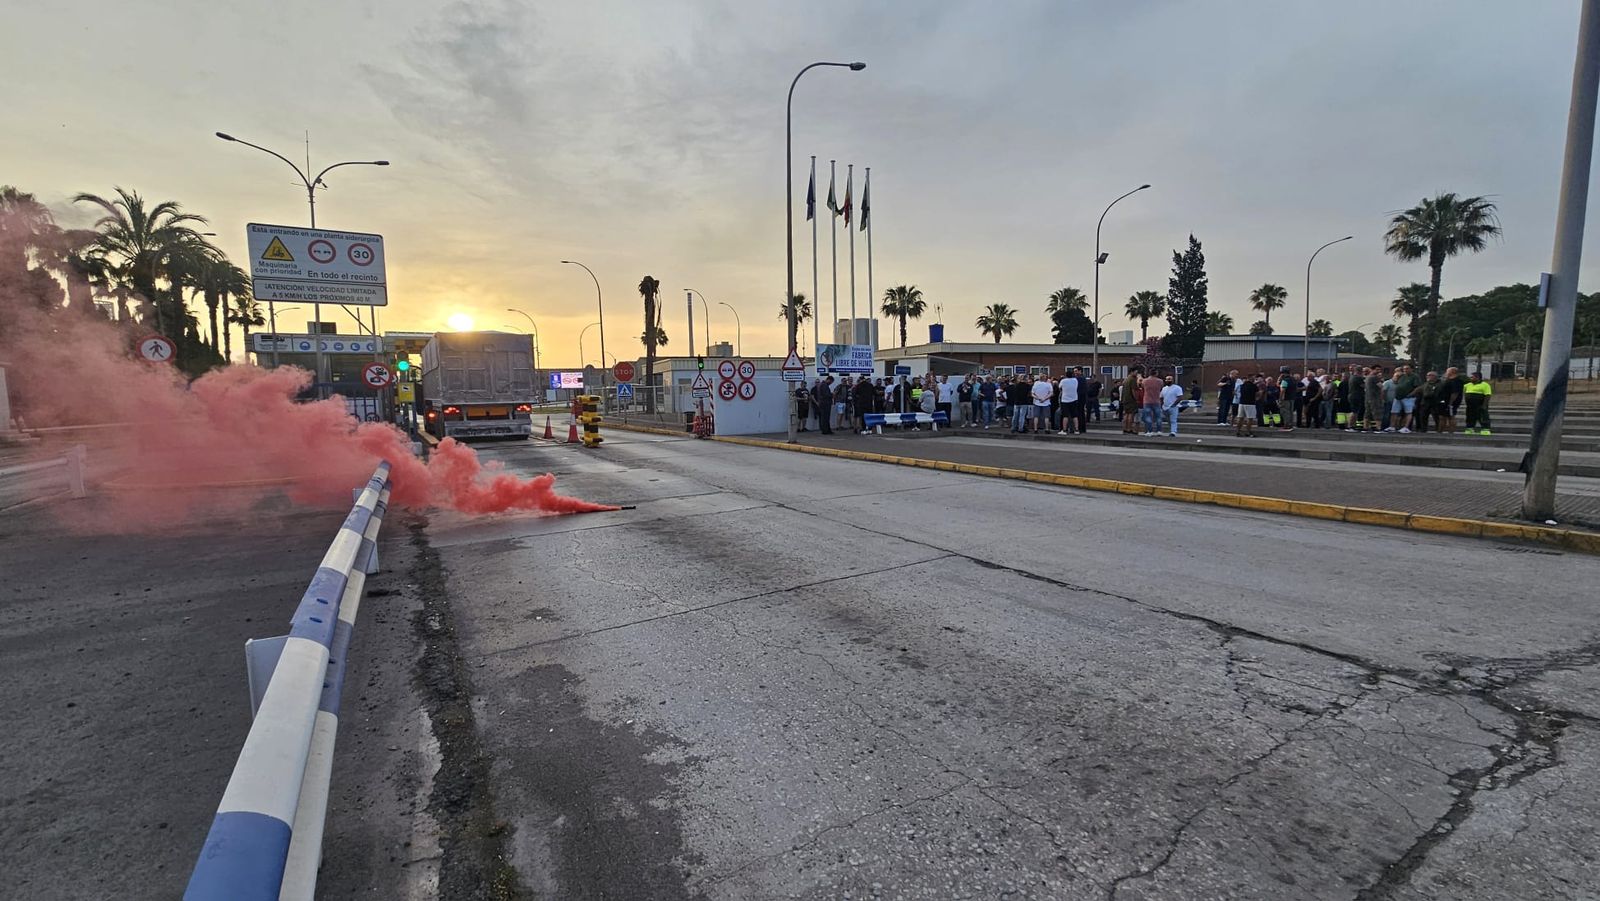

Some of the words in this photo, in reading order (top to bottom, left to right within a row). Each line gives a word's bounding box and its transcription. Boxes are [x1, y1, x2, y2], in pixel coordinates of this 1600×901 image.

[270, 228, 300, 236] entrando
[354, 250, 369, 259] 30
[258, 260, 298, 269] Maquinaria
[270, 268, 302, 276] prioridad
[306, 286, 345, 294] VELOCIDAD
[859, 360, 872, 368] HUMO
